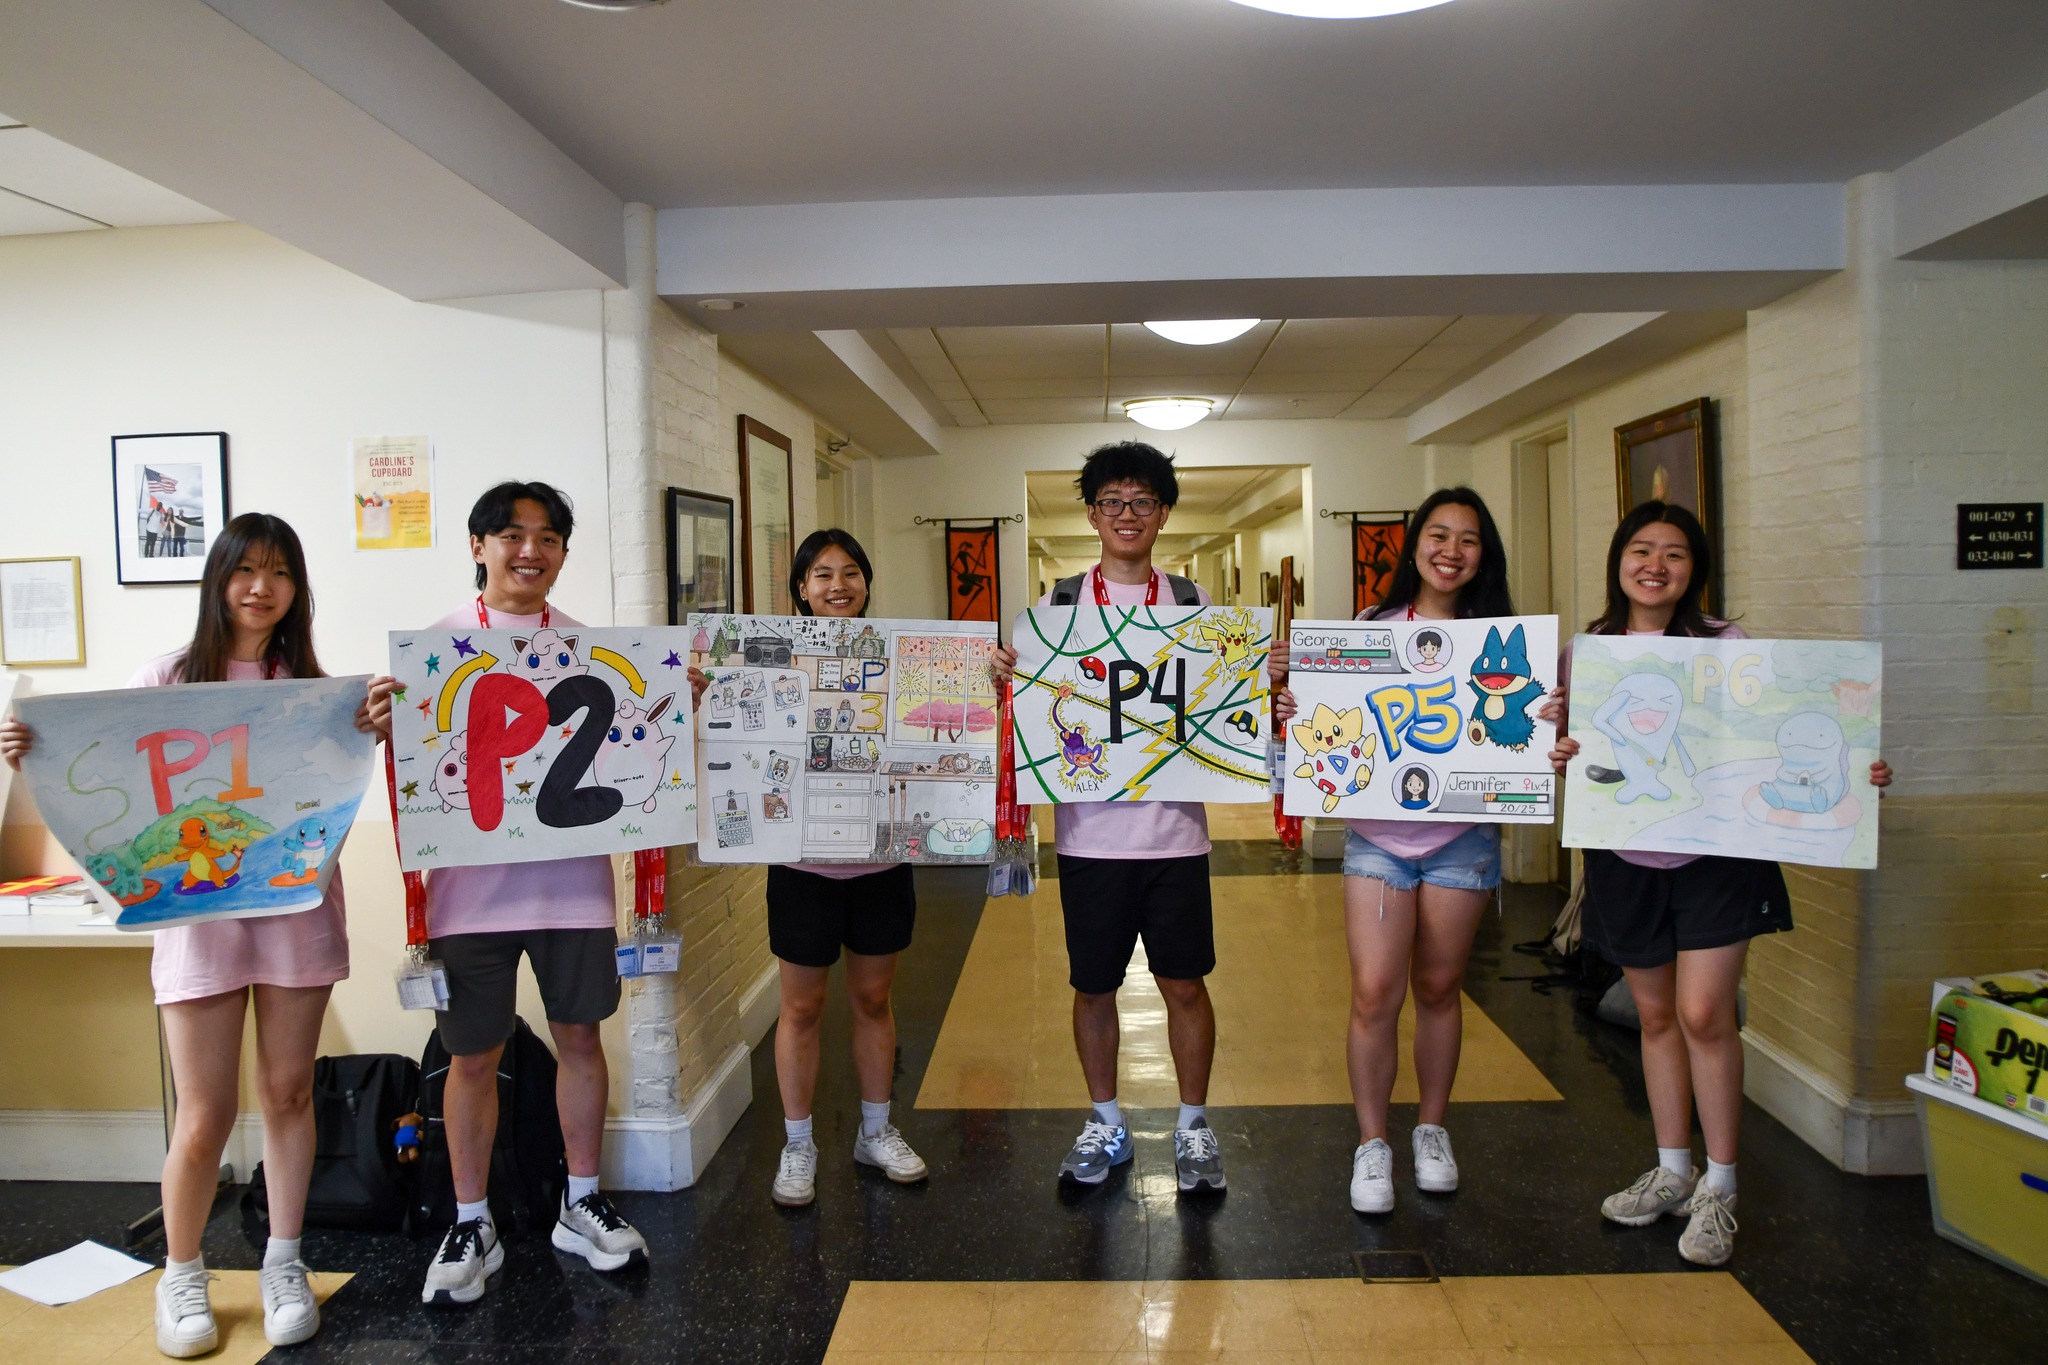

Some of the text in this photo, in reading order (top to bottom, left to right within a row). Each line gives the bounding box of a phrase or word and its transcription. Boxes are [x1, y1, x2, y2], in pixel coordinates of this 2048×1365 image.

[369, 456, 415, 467] CAROLINE'S
[371, 467, 413, 478] CUPBOARD
[1968, 511, 2015, 522] 001-029
[1988, 531, 2033, 542] 030-031
[1967, 551, 2014, 562] 032-040
[1292, 631, 1348, 650] George
[1327, 649, 1341, 662] HP
[718, 673, 741, 684] WMACS
[862, 661, 886, 690] P
[1692, 653, 1763, 708] P6
[1109, 658, 1186, 743] P4
[856, 695, 883, 731] 3
[1365, 675, 1463, 763] P5
[467, 672, 624, 832] P2
[136, 723, 264, 816] P1
[1076, 779, 1100, 793] ALEX
[1449, 776, 1511, 791] Jennifer
[1484, 794, 1496, 802] HP
[295, 799, 321, 812] Daniel
[1500, 803, 1536, 814] 20/25
[1655, 1186, 1675, 1202] N
